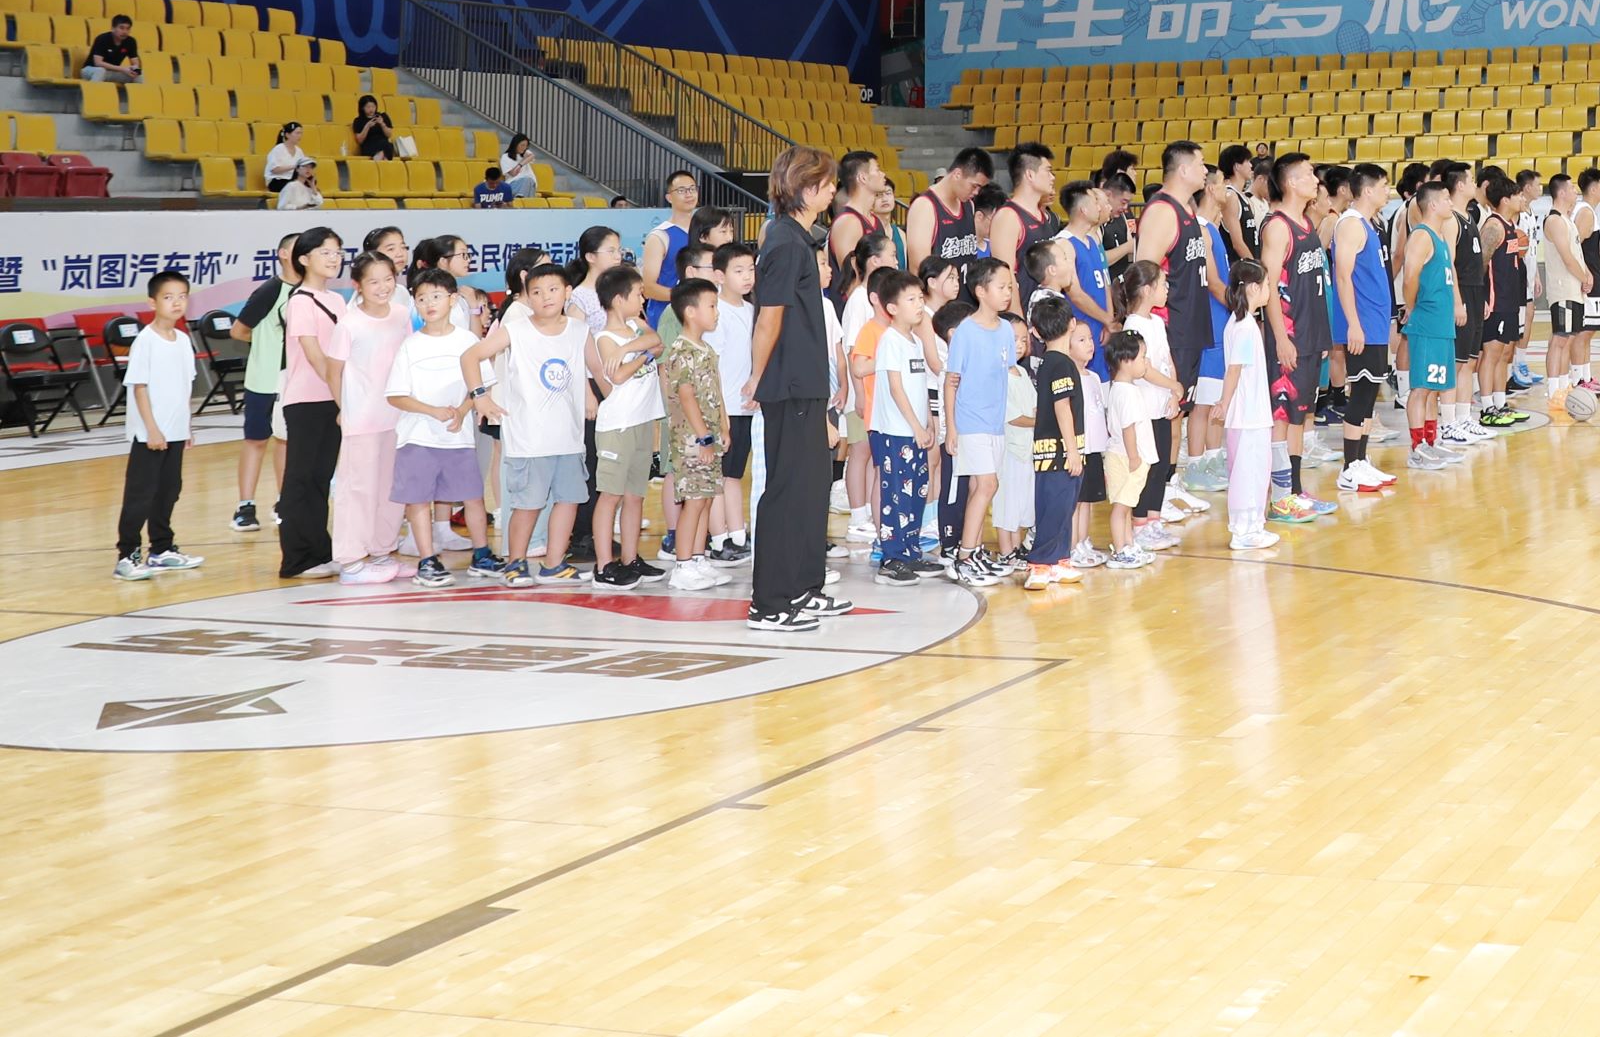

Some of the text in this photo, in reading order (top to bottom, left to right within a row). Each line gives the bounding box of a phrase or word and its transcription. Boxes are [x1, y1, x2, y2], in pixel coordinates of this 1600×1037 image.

[1316, 275, 1323, 296] 7
[1497, 320, 1505, 335] 4
[1427, 363, 1447, 385] 23
